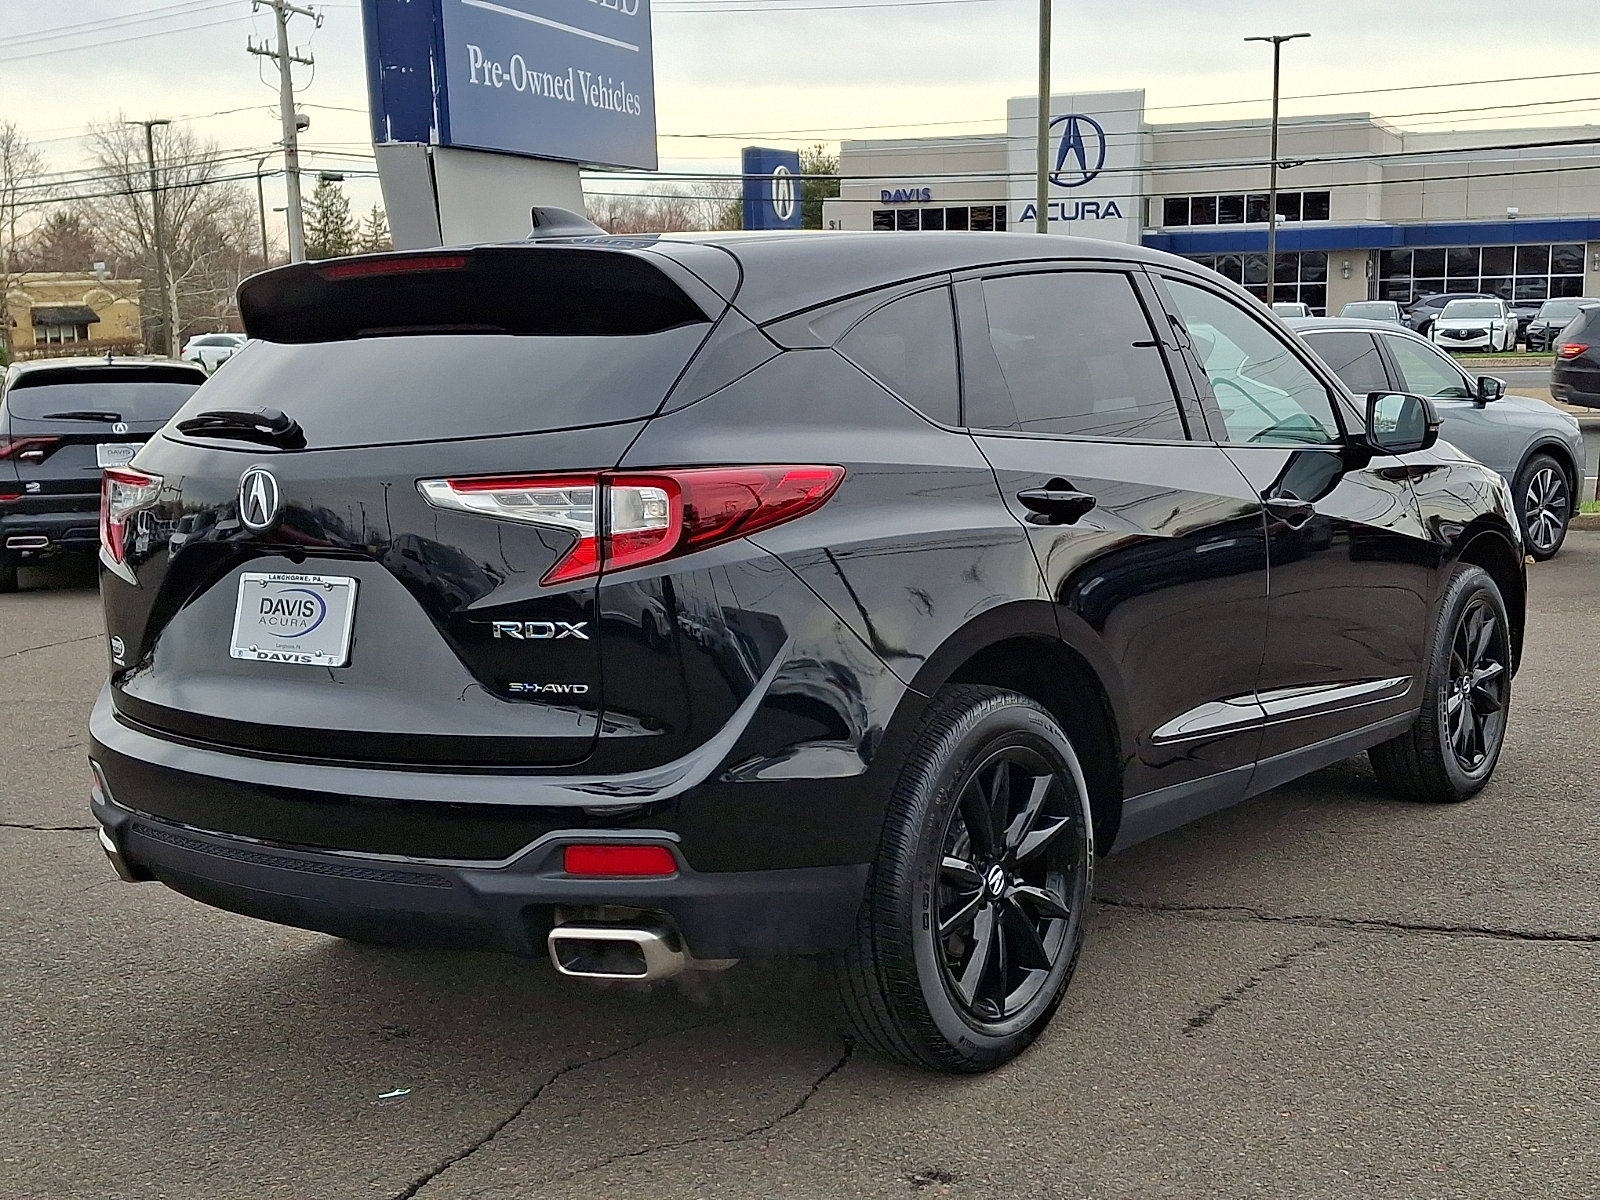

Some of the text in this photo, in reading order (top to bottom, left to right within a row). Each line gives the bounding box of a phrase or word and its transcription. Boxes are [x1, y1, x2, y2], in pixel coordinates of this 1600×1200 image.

[466, 44, 641, 116] Pre-Owned Vehicles
[881, 187, 931, 203] DAVIS
[259, 597, 315, 618] DAVIS
[258, 616, 308, 628] ACURA
[492, 621, 590, 640] RDX
[256, 651, 312, 663] DAVIS
